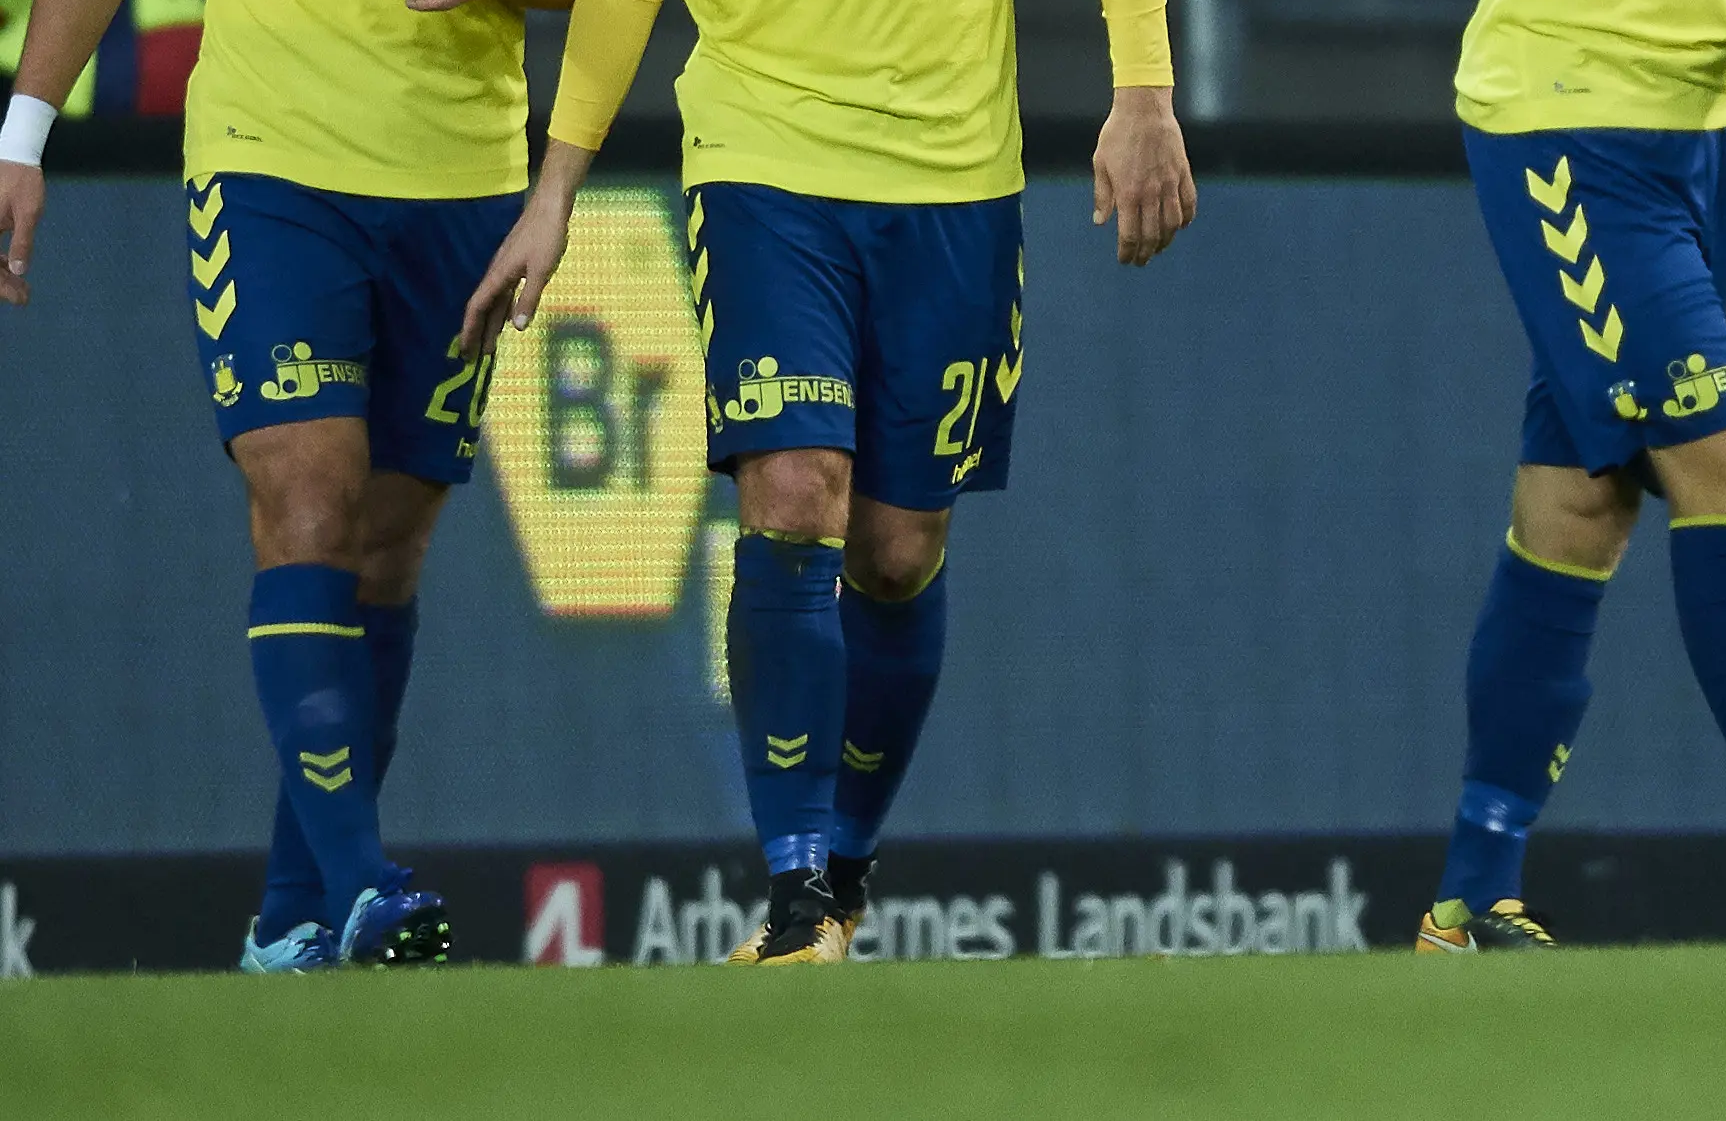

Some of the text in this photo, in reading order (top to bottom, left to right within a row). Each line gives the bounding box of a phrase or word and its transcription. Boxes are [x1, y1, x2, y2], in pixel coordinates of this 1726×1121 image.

[933, 357, 988, 456] 21
[633, 865, 1017, 966] Arbernes
[1038, 857, 1367, 960] Landsbank
